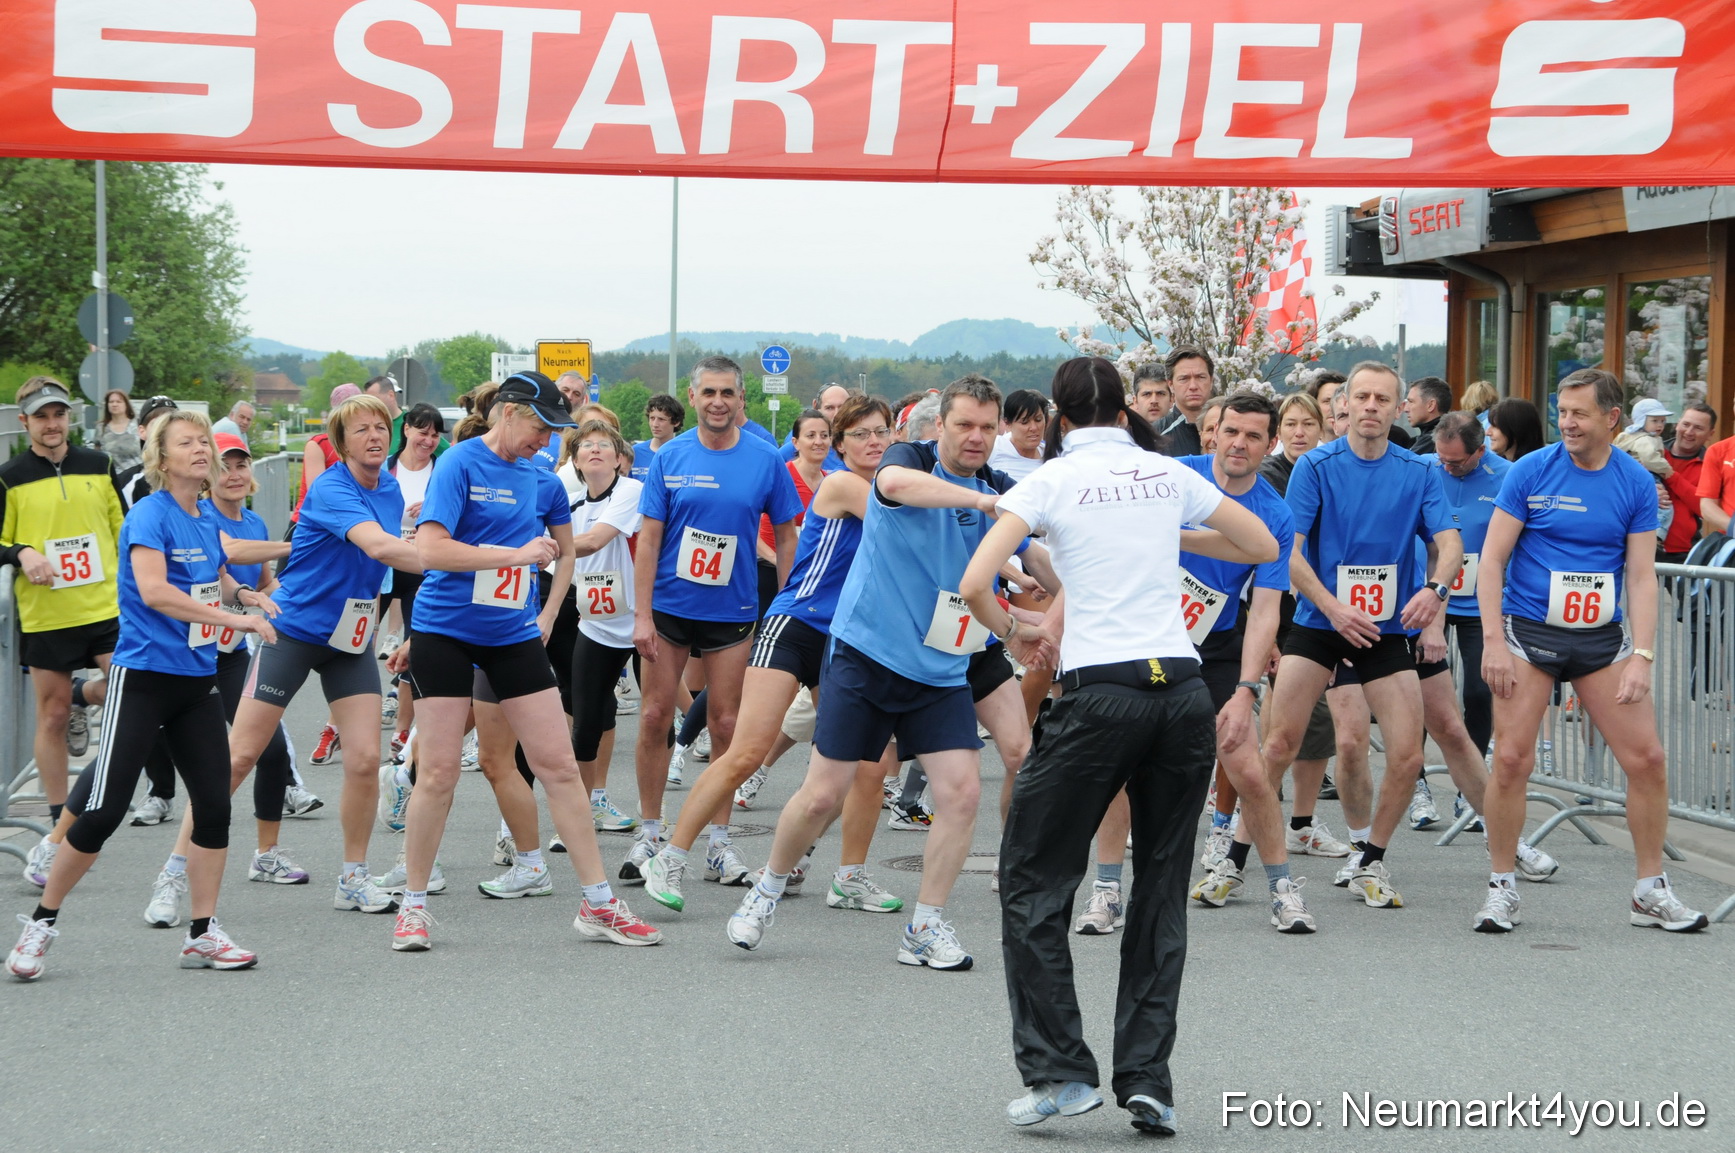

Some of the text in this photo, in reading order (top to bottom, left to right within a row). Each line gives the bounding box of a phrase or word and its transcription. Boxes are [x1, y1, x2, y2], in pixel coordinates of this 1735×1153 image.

[1409, 198, 1465, 236] SEAT
[543, 357, 585, 367] Neumarkt
[1078, 482, 1180, 505] ZEITLOS
[54, 539, 80, 548] MEYER
[690, 537, 716, 548] WERBUNG
[691, 531, 717, 543] MEYER
[60, 551, 91, 582] 53
[690, 548, 722, 580] 64
[1348, 568, 1376, 576] MEYER
[493, 566, 522, 602] 21
[584, 575, 605, 583] MEYER
[1183, 576, 1209, 597] MEYER
[1562, 574, 1593, 583] MEYER
[1562, 581, 1593, 589] WERBUNG
[587, 587, 616, 615] 25
[1350, 584, 1384, 617] 63
[1562, 591, 1601, 624] 66
[351, 616, 368, 648] 9
[955, 614, 971, 648] 1
[259, 684, 286, 697] ODLO
